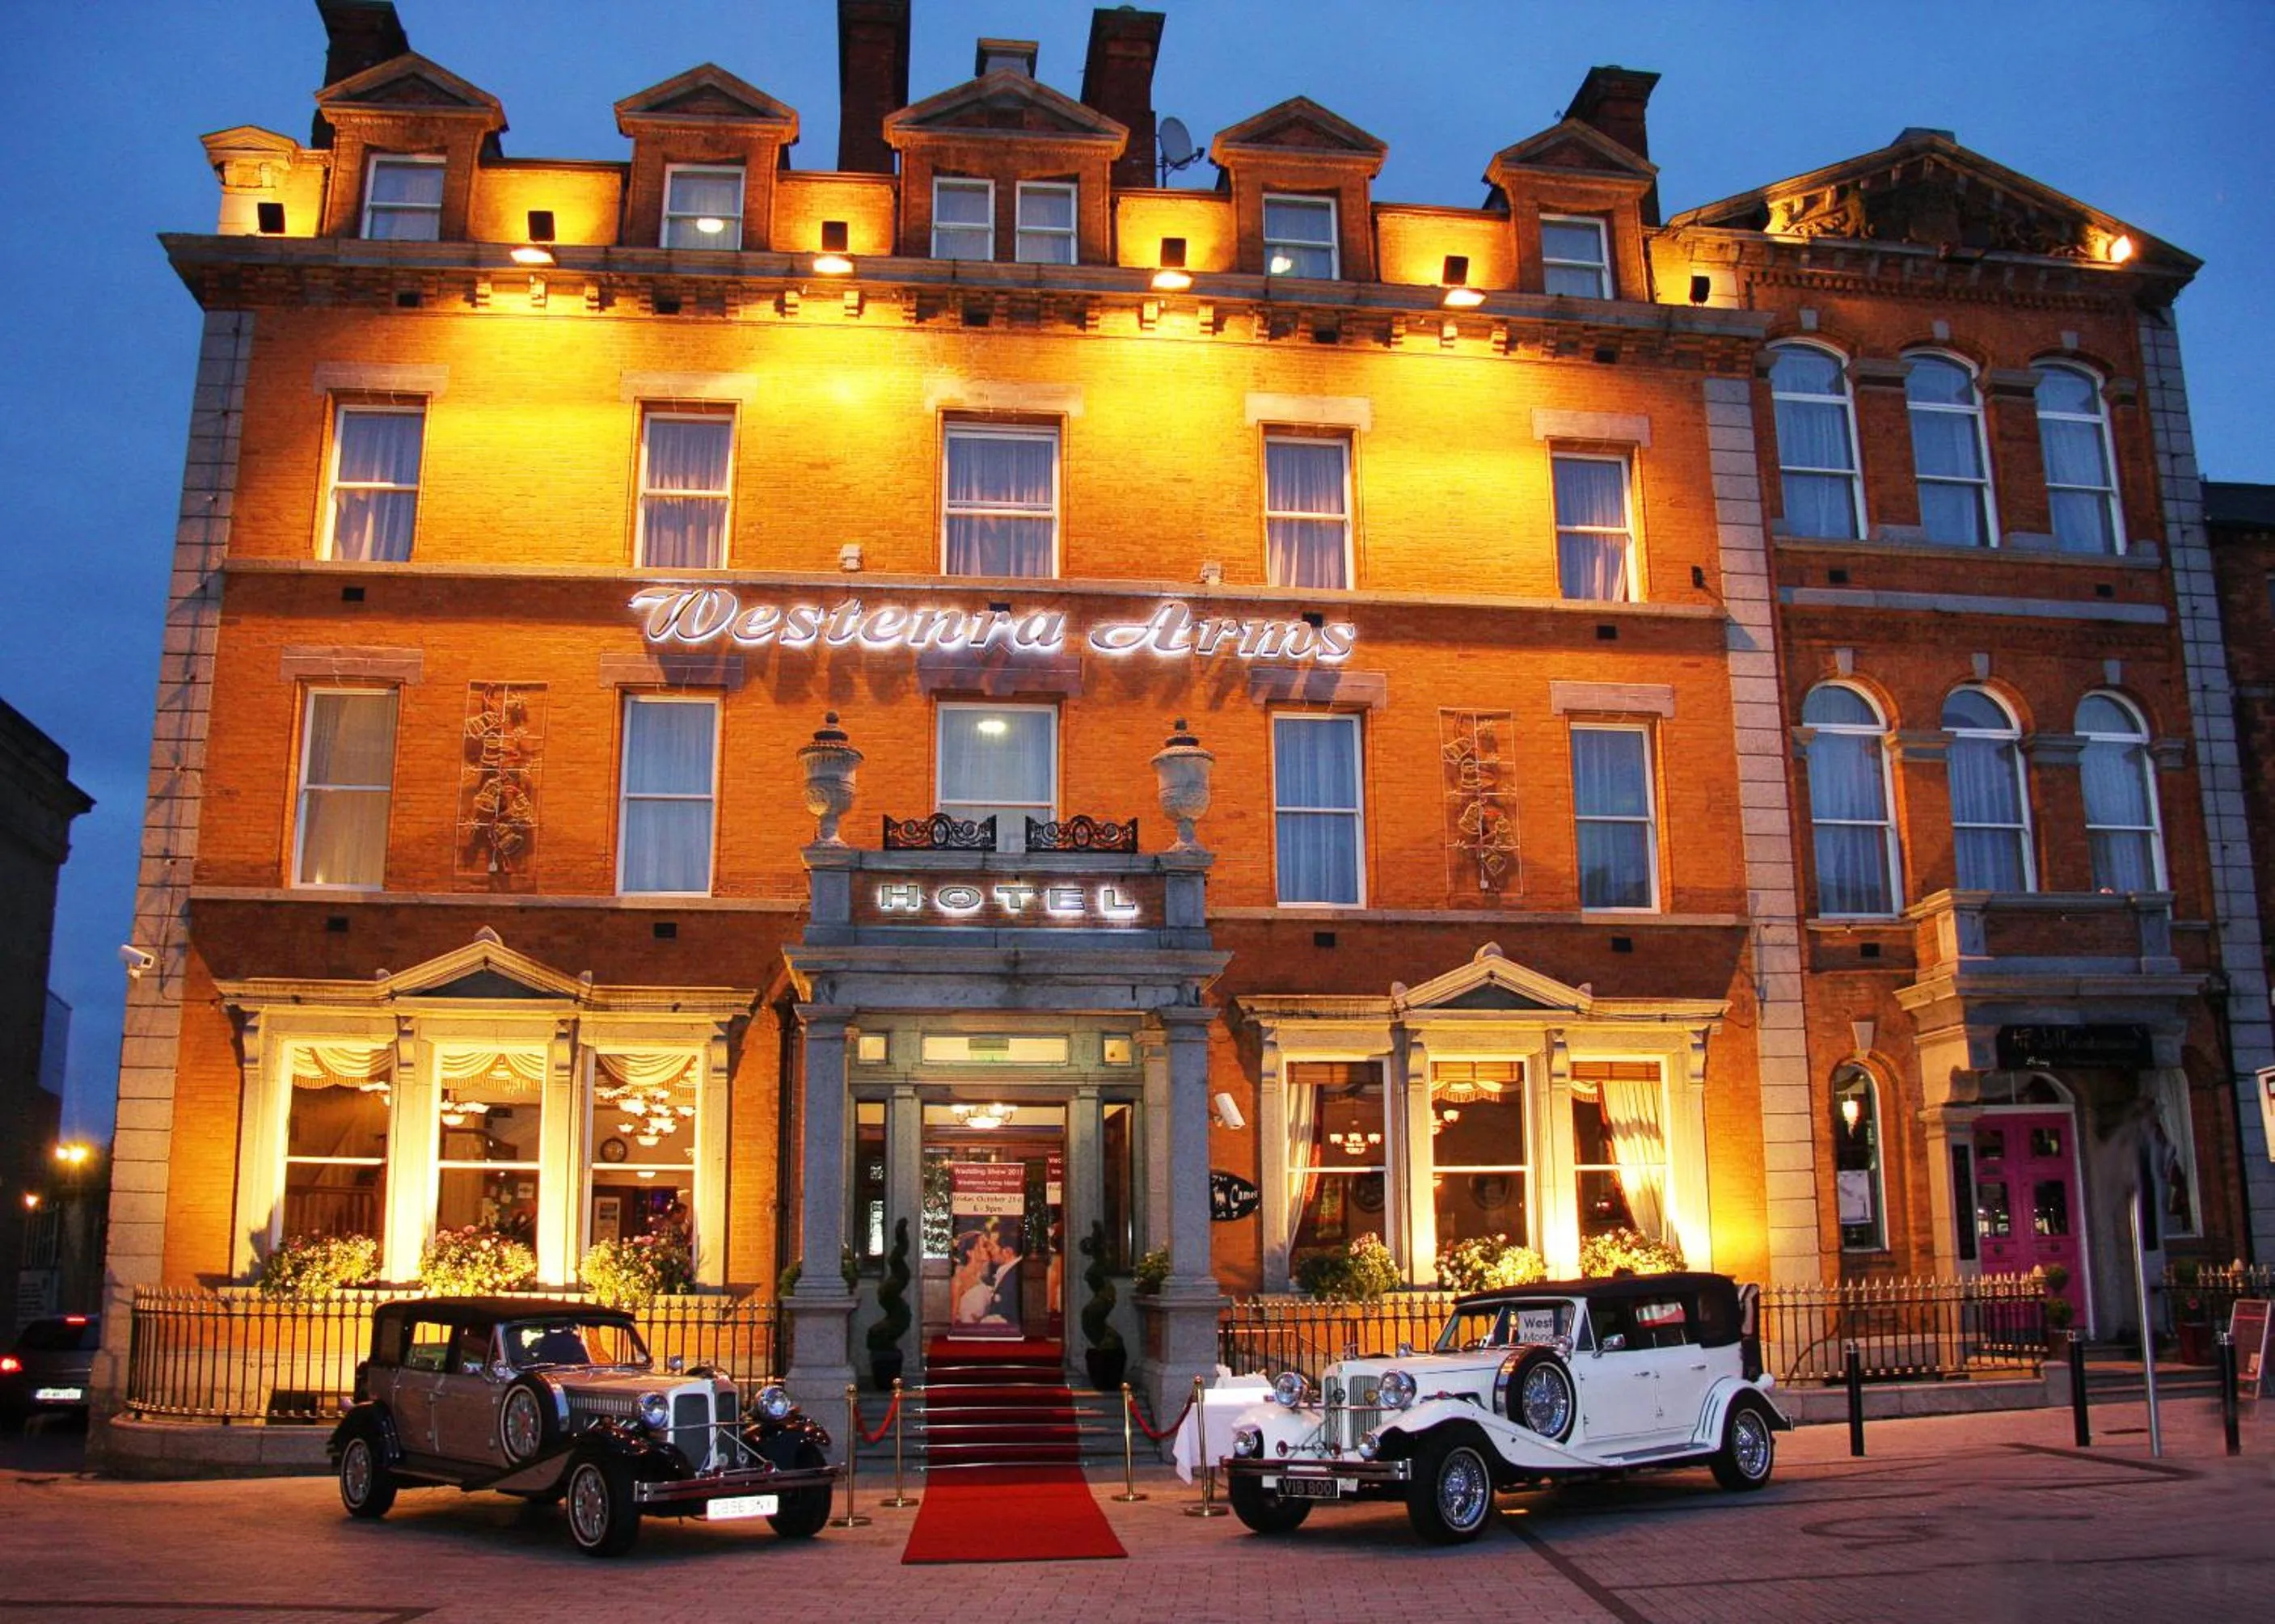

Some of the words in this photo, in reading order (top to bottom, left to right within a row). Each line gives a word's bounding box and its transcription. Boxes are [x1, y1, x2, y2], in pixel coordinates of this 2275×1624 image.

[628, 588, 1063, 647] Westenra
[1090, 601, 1356, 660] Arms
[880, 884, 1136, 912] HOTEL
[1307, 1481, 1332, 1495] 800
